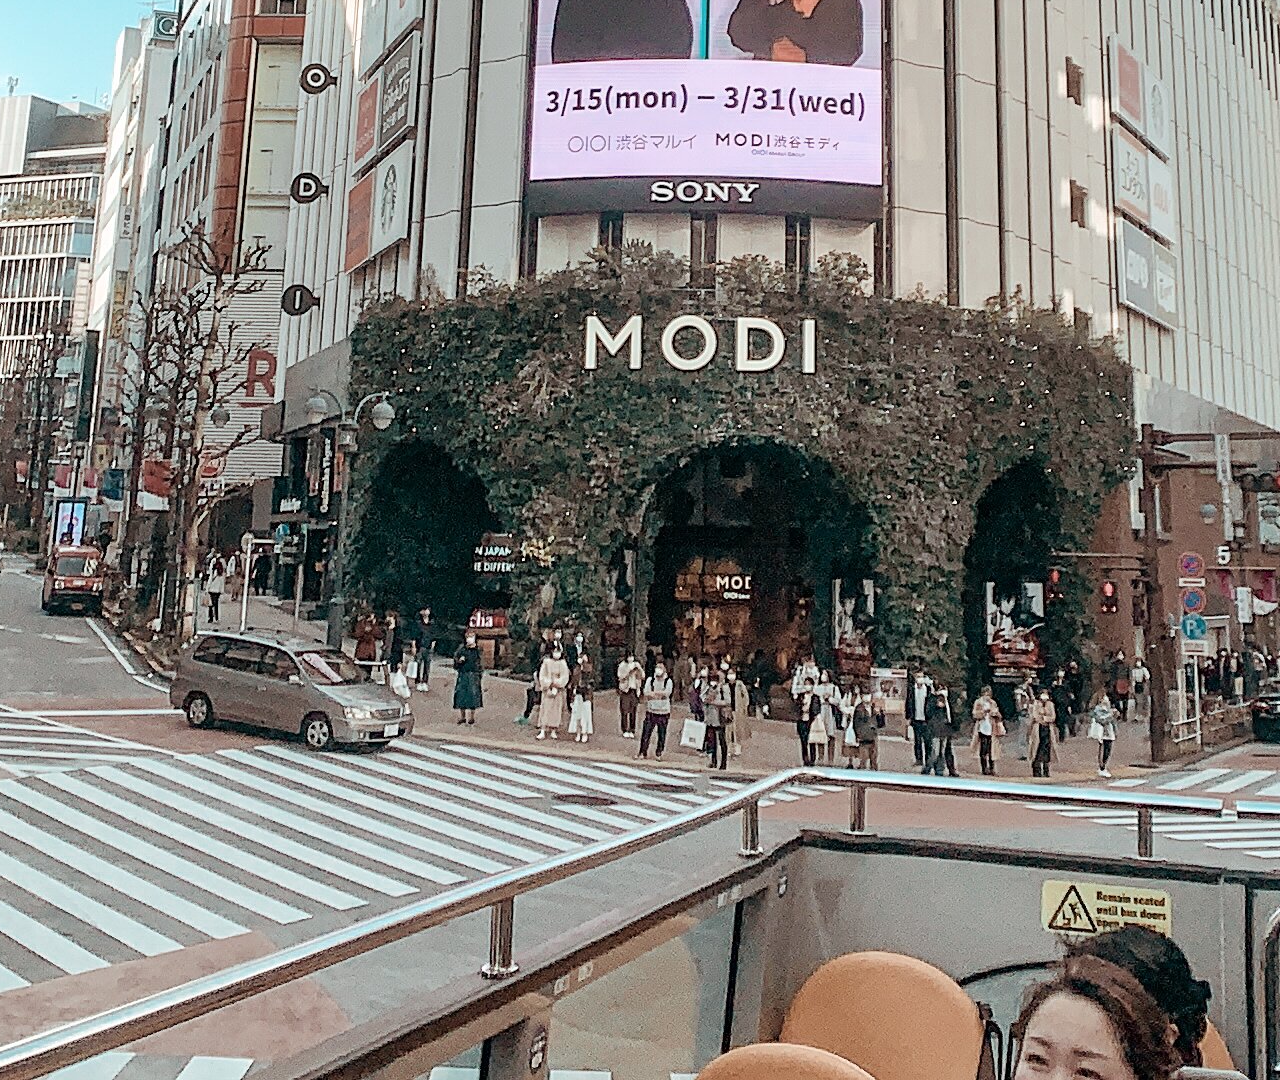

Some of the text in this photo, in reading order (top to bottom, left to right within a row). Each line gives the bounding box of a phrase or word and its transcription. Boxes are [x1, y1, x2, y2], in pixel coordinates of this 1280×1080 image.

[546, 84, 688, 117] 3/15(mon)
[723, 85, 866, 121] 3/31(wed)
[616, 134, 697, 151] 渋谷マルイ
[715, 132, 841, 151] MODI 渋谷モディ
[650, 181, 760, 203] SONY
[584, 315, 817, 375] MODI
[1096, 891, 1165, 906] Remain seated
[1096, 906, 1118, 915] until
